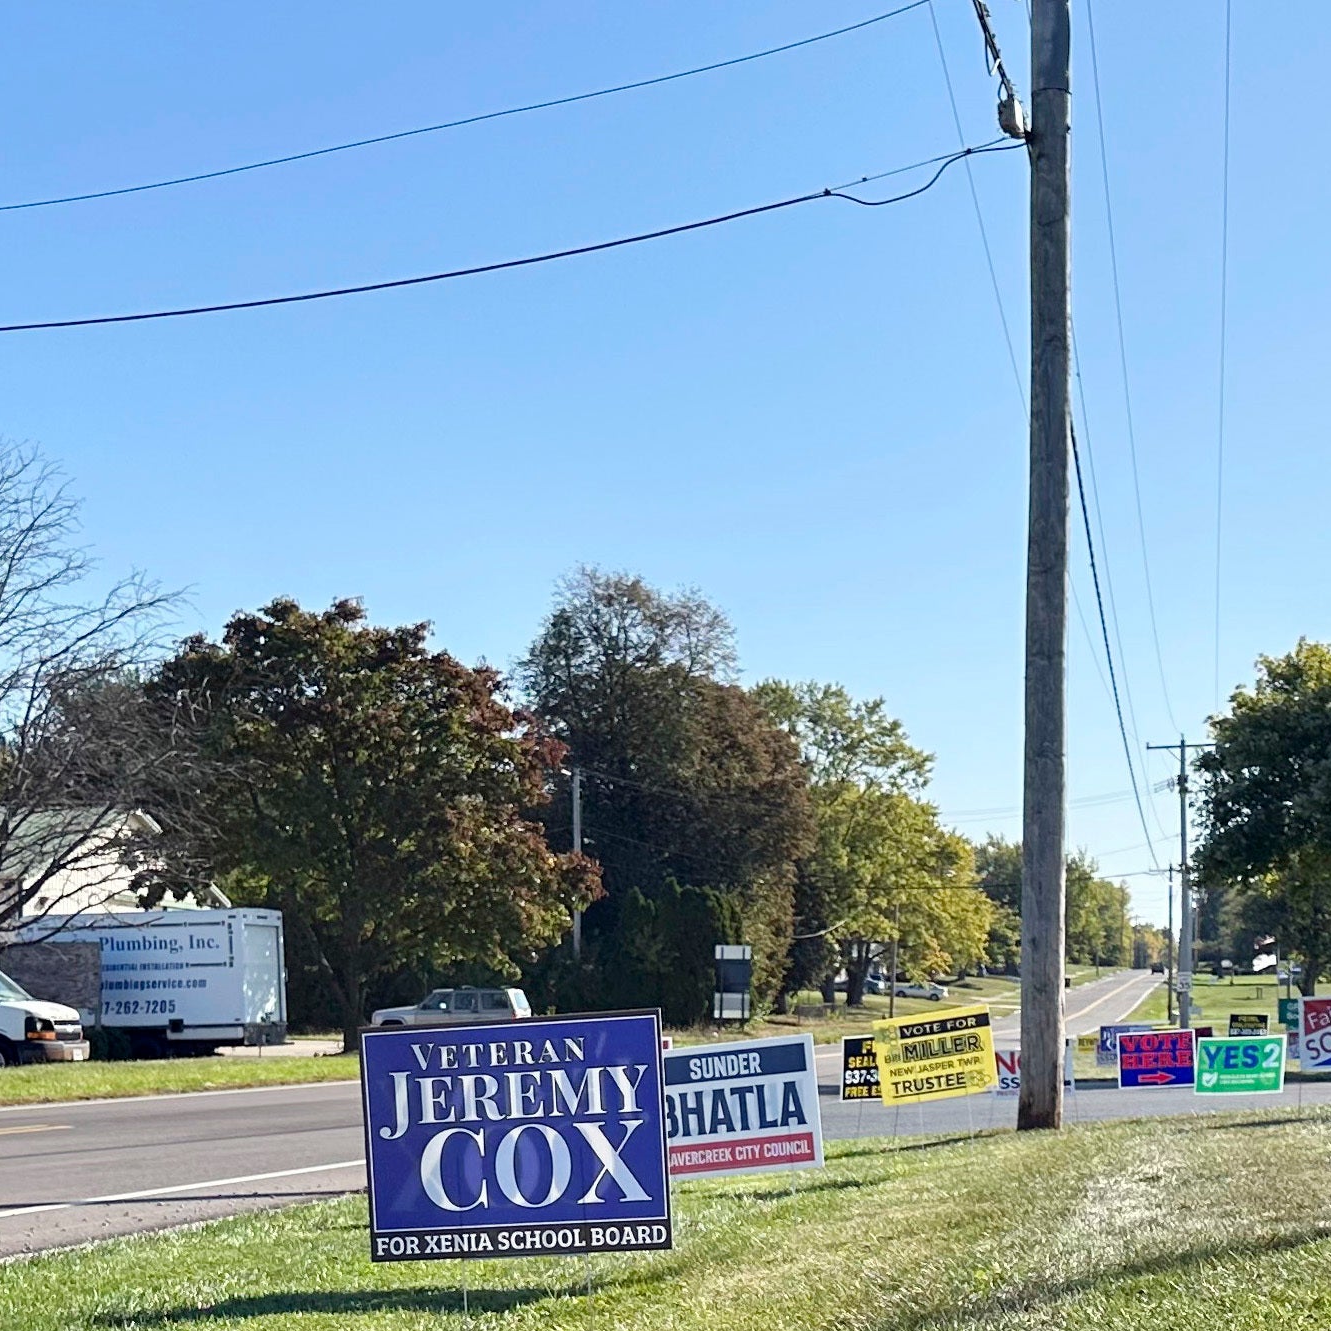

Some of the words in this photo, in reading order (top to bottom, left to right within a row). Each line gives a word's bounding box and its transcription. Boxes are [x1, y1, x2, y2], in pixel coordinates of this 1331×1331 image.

[99, 936, 183, 954] Plumbing,
[189, 934, 220, 949] Inc.
[101, 963, 138, 972] ESIDENTIAL
[902, 1023, 942, 1037] VOTE
[946, 1017, 977, 1029] FOR
[411, 1037, 586, 1071] VETERAN
[901, 1033, 984, 1063] MILLER
[1120, 1033, 1192, 1051] VOTE
[689, 1052, 762, 1080] SUNDER
[889, 1065, 913, 1077] NEW
[917, 1060, 955, 1073] JASPER
[1122, 1050, 1193, 1069] HERE
[1202, 1044, 1260, 1069] YES
[1263, 1043, 1280, 1068] 2
[891, 1072, 966, 1095] TRUSTEE
[380, 1064, 649, 1140] JEREMY
[666, 1081, 808, 1139] BHATLA
[420, 1119, 653, 1212] COX
[669, 1147, 732, 1167] AVERCREEK
[735, 1143, 761, 1160] CITY
[764, 1139, 811, 1156] COUNCIL
[377, 1236, 421, 1256] FOR
[425, 1232, 493, 1253] XENIA
[497, 1228, 586, 1250] SCHOOL
[591, 1225, 667, 1246] BOARD
